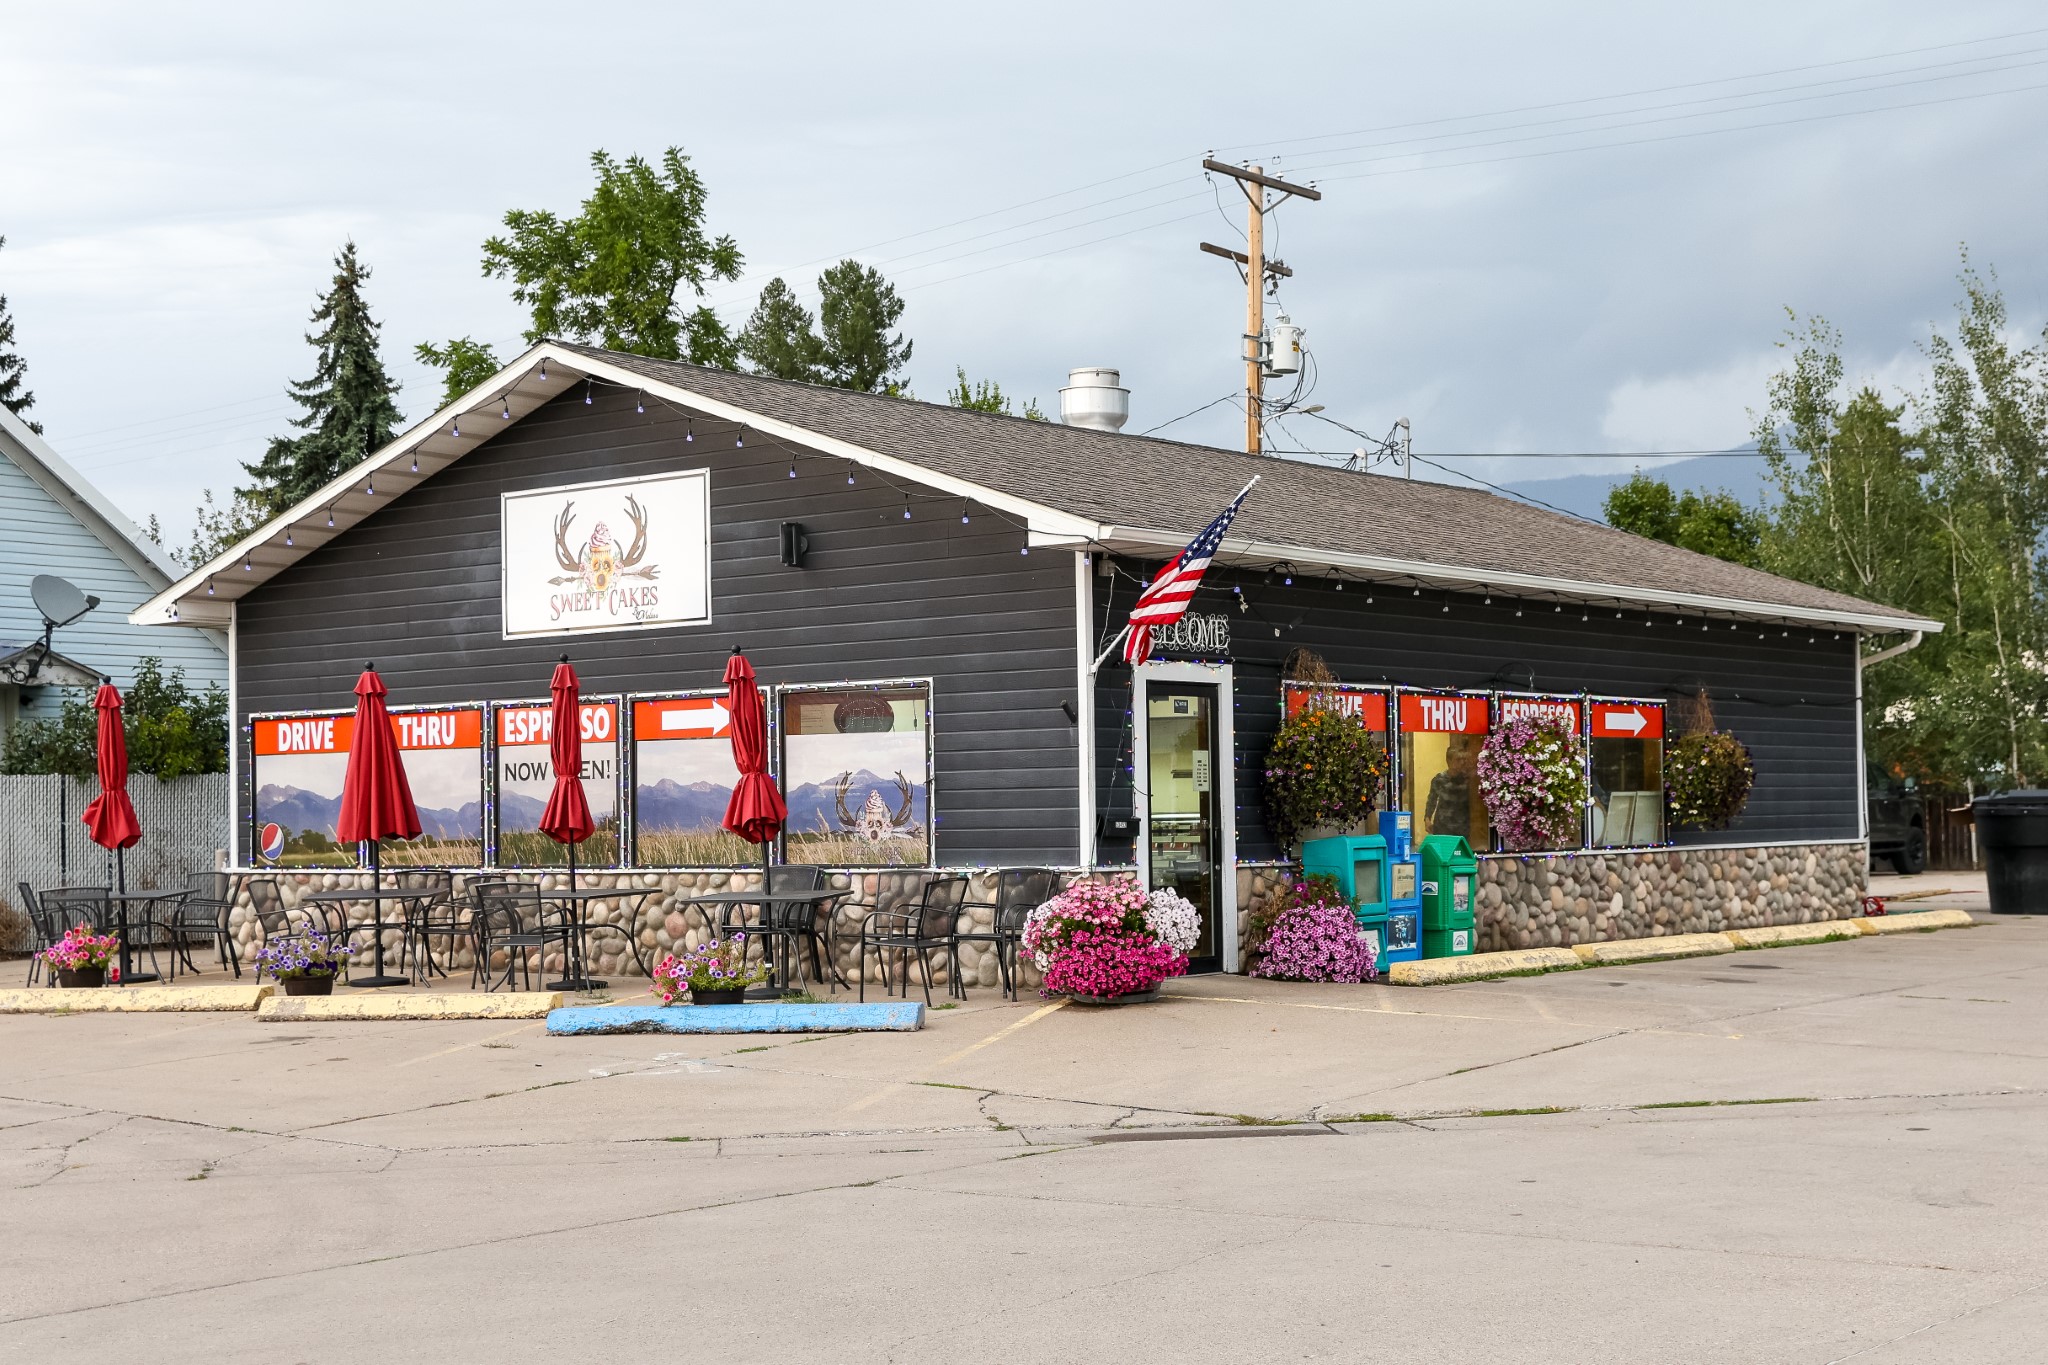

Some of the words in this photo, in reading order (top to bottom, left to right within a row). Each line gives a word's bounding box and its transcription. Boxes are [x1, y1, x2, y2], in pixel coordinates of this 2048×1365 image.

[550, 591, 604, 621] SWEET
[609, 586, 659, 616] CAKES
[1149, 612, 1230, 653] ELCOME
[504, 707, 610, 743] ESPRSO
[839, 706, 885, 730] OPEN
[1420, 700, 1467, 731] THRU
[277, 720, 334, 752] DRIVE
[398, 715, 456, 747] THRU
[505, 762, 548, 781] NOW
[553, 760, 610, 780] EN!
